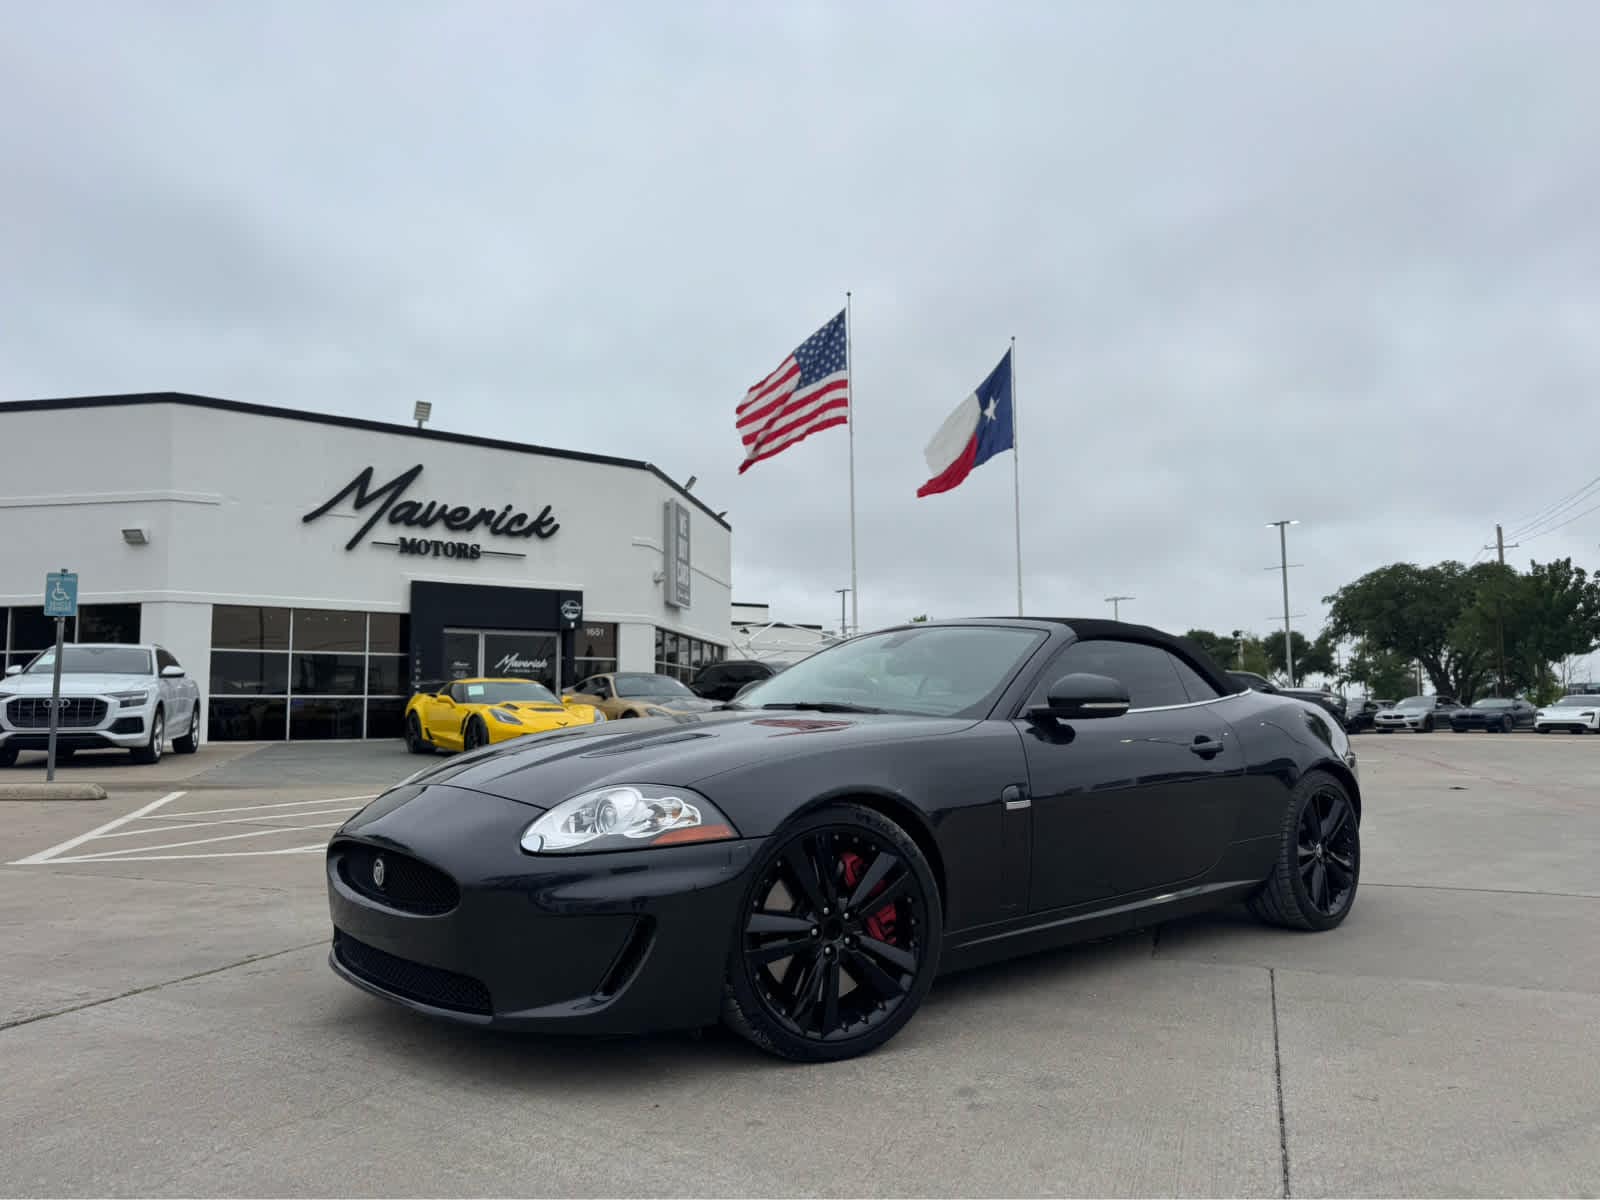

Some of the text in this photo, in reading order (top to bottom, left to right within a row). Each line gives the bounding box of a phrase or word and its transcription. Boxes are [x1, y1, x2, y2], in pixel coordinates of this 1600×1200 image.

[302, 464, 560, 551] Maverick
[398, 537, 481, 560] MOTORS
[494, 652, 548, 673] Maverick
